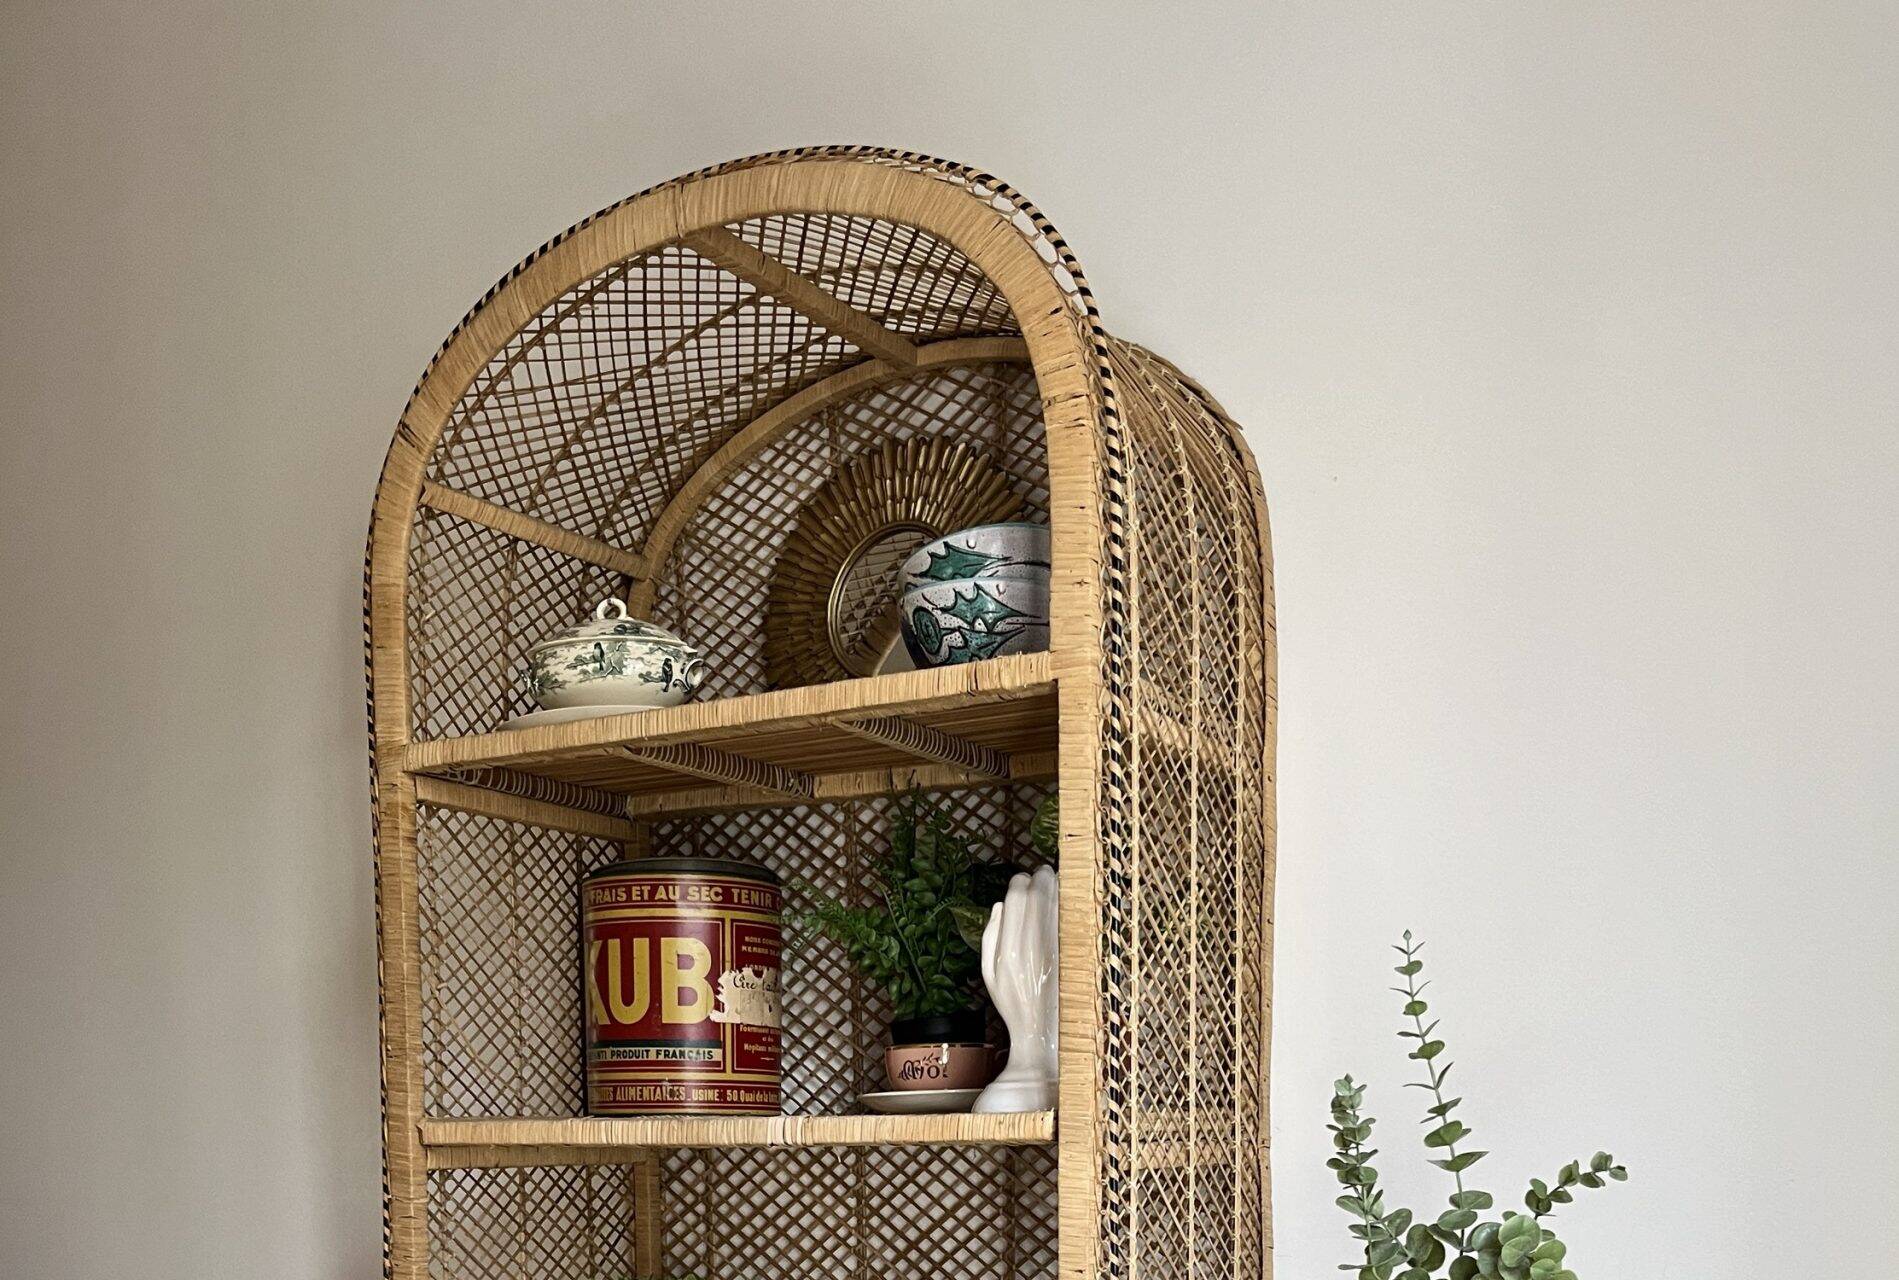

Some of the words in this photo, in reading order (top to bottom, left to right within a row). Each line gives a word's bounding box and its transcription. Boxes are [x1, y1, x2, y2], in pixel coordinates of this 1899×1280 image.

[590, 887, 627, 904] FRAIS
[632, 885, 651, 901] ET
[655, 885, 681, 901] AU
[687, 886, 723, 902] SEC
[732, 888, 772, 908] TENIR
[611, 1049, 651, 1060] PRODUIT
[726, 1089, 738, 1101] 50
